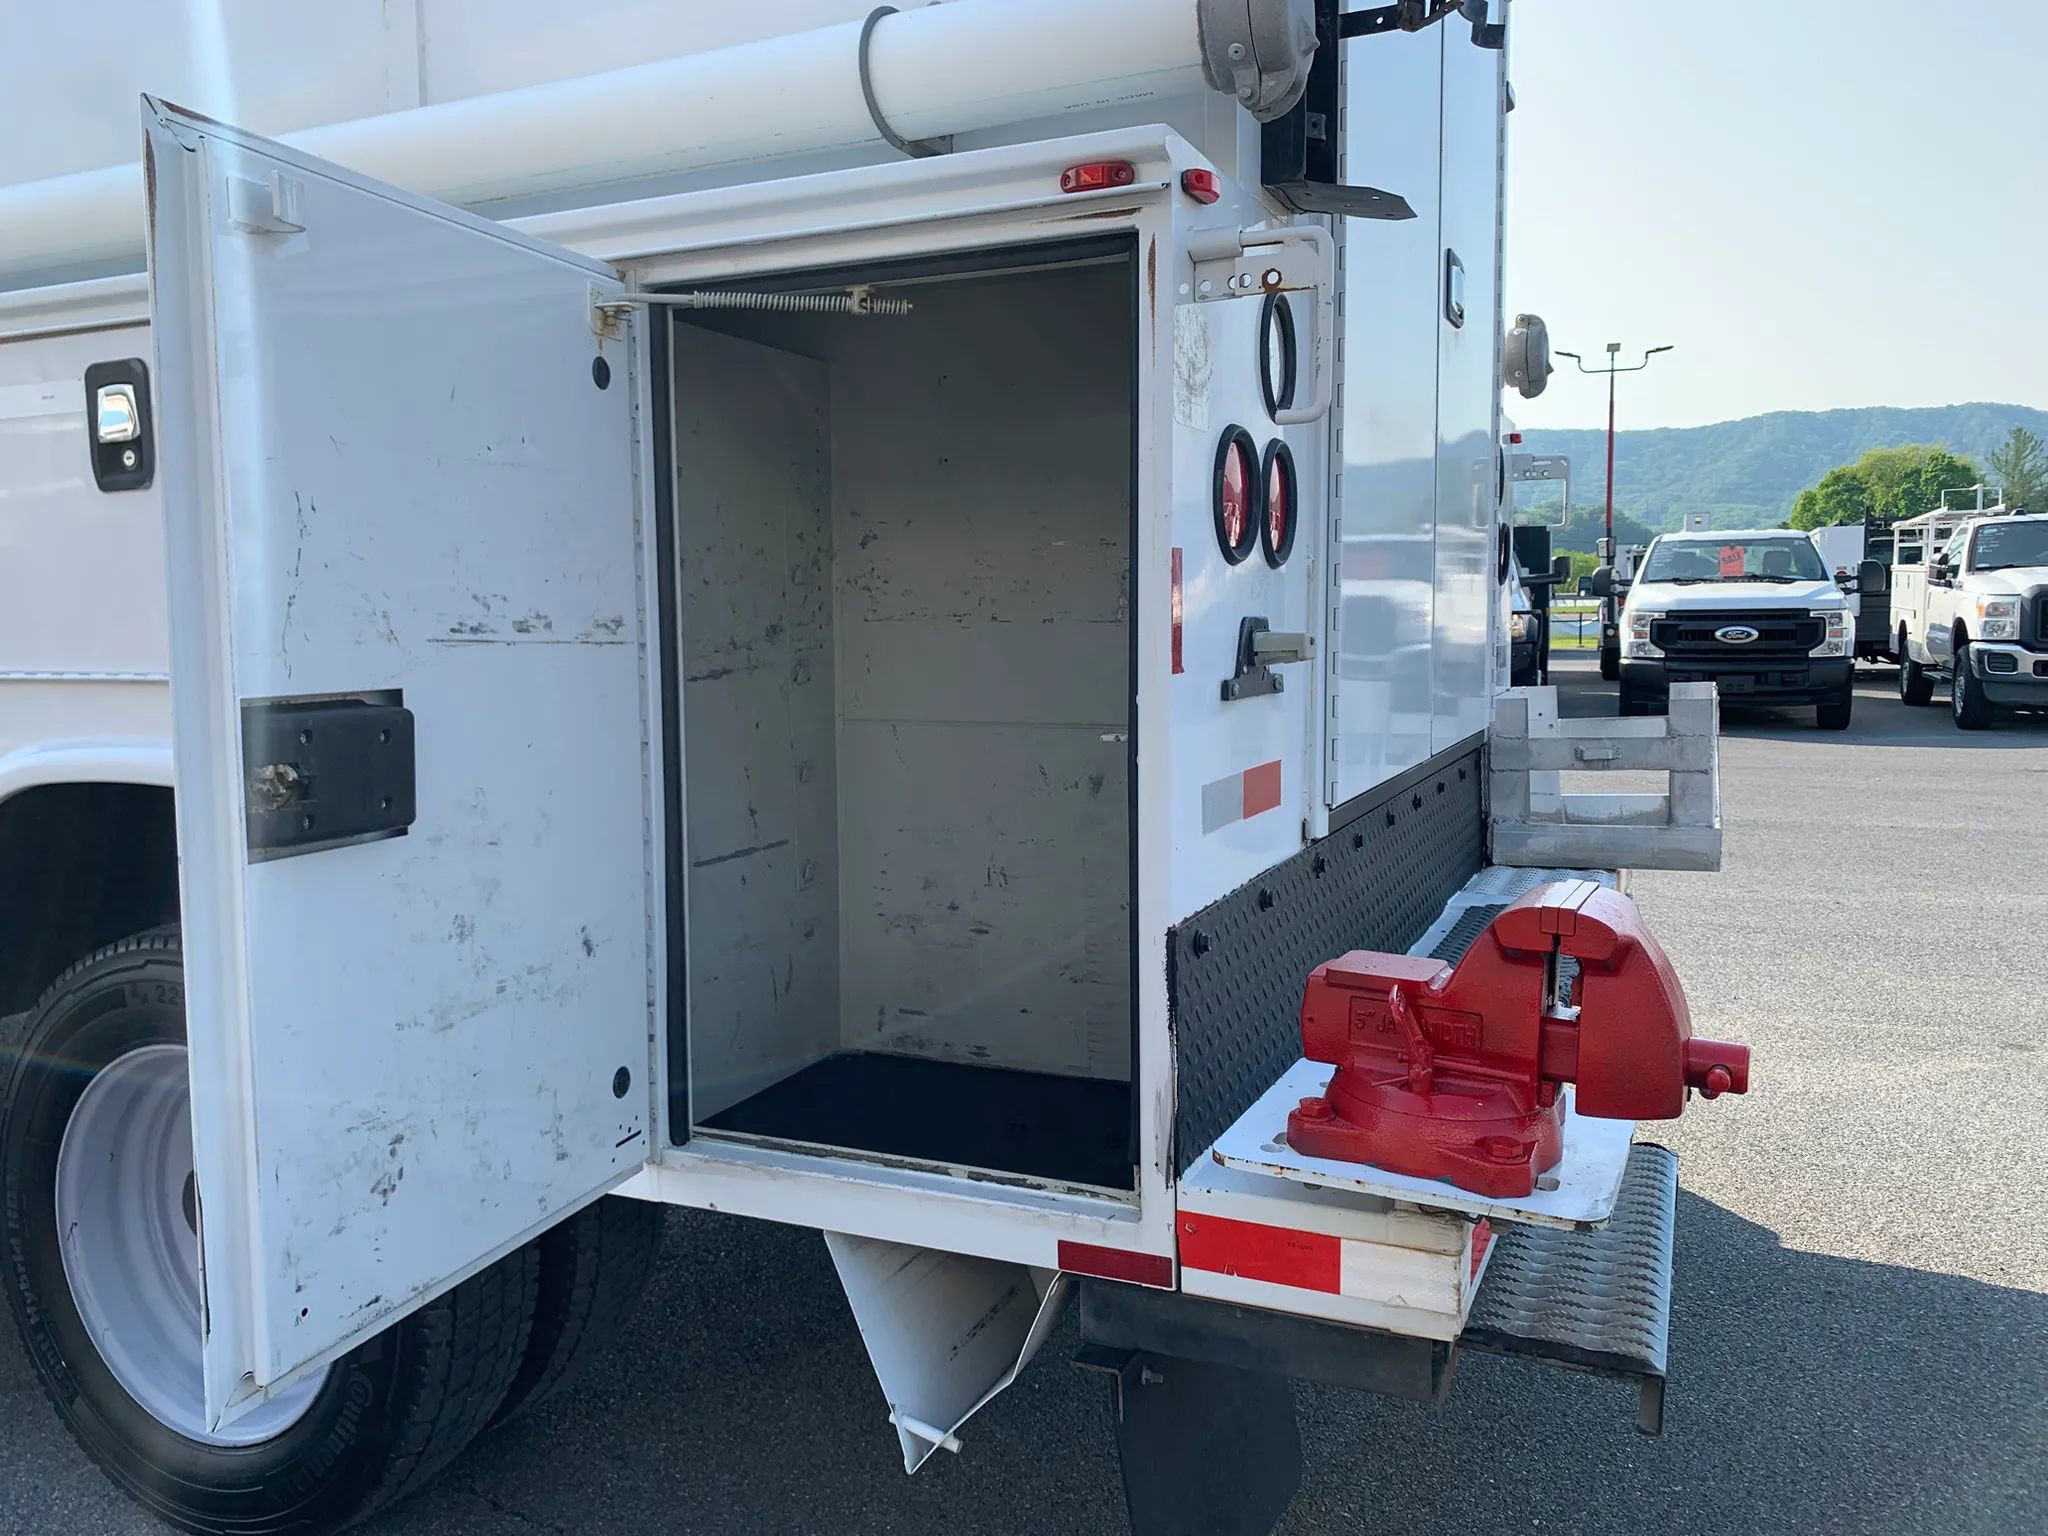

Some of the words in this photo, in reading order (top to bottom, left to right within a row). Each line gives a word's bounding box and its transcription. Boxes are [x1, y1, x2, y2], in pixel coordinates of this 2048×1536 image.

[1722, 551, 1742, 564] SALE
[1376, 1014, 1398, 1036] JA
[1421, 1018, 1478, 1048] WIDTH
